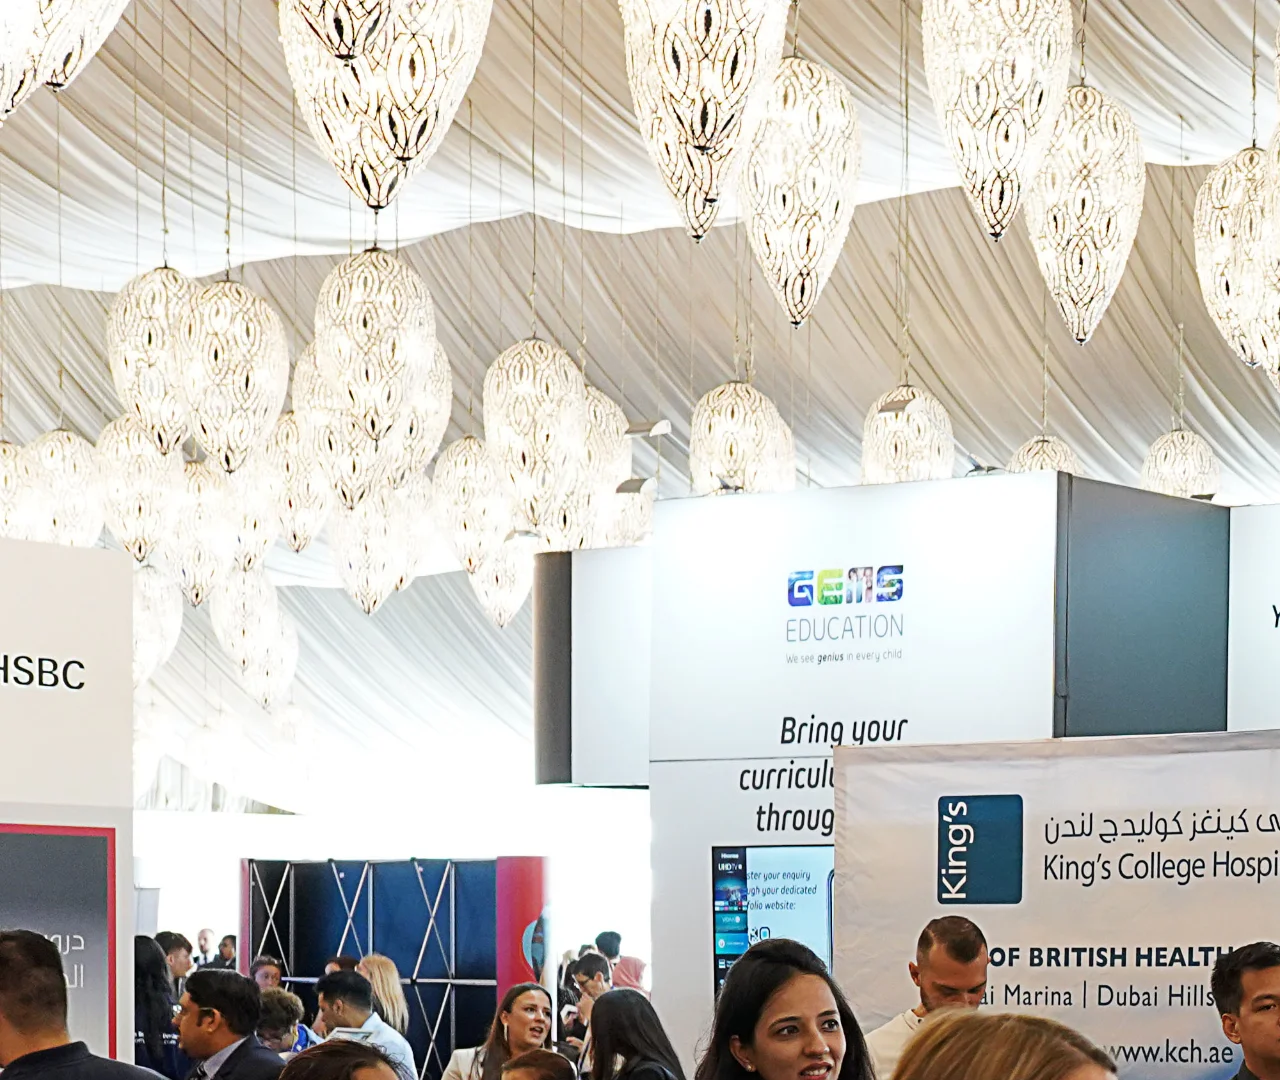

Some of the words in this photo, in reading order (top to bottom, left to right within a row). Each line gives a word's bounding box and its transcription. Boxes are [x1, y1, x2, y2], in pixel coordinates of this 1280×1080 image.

[788, 565, 904, 607] GEMS
[786, 614, 904, 642] EDUCATION
[785, 653, 798, 663] We
[800, 655, 815, 663] see
[817, 652, 844, 665] genius
[846, 652, 854, 661] in
[856, 651, 880, 662] every
[883, 648, 902, 660] child
[780, 714, 844, 748] Bring
[852, 719, 908, 745] your
[739, 759, 834, 790] curricul
[756, 802, 834, 837] throug
[1044, 812, 1093, 845] لندن
[1099, 811, 1183, 844] كوليدج
[1189, 808, 1249, 842] كينغز
[941, 801, 975, 899] King's
[747, 872, 762, 880] ster
[763, 874, 781, 882] your
[782, 870, 811, 881] enquiry
[1044, 852, 1112, 887] King's
[1118, 851, 1206, 886] College
[747, 886, 760, 896] ugh
[762, 888, 779, 897] your
[781, 885, 817, 895] dedicated
[747, 901, 763, 910] folio
[765, 901, 796, 911] website:
[989, 947, 1020, 967] OF
[1029, 947, 1127, 967] BRITISH
[1004, 984, 1073, 1007] Marina
[1097, 984, 1158, 1007] Dubai
[1168, 983, 1215, 1007] Hills
[1104, 1039, 1234, 1063] www.kch.ae
